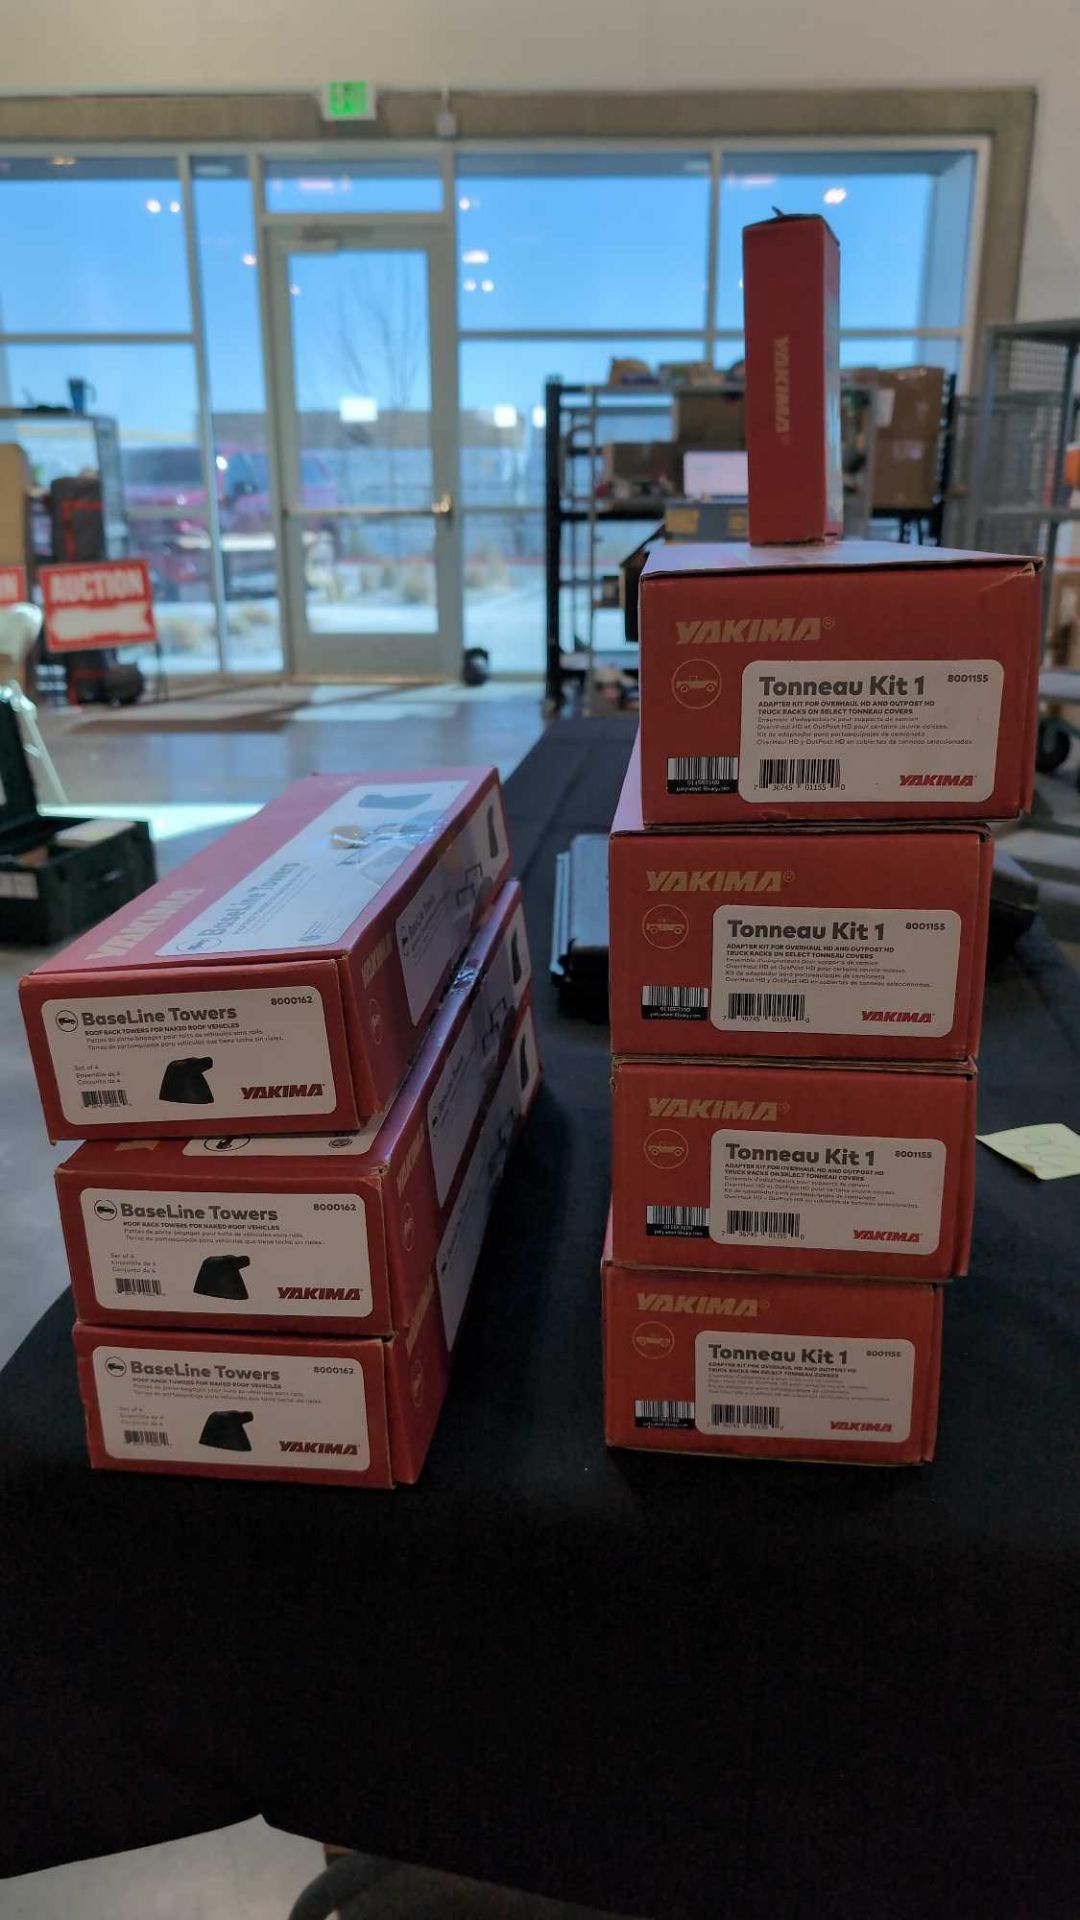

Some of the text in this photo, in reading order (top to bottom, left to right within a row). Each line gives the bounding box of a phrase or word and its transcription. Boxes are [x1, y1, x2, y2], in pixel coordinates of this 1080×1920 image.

[52, 568, 144, 602] AUCTION
[676, 617, 821, 645] YAKIMA
[759, 674, 925, 697] Tonneau Kit 1
[947, 674, 989, 683] 8001155
[900, 775, 974, 787] YAKIMA
[646, 871, 783, 892] YAKIMA
[727, 920, 885, 941] Tonneau Kit 1
[905, 922, 946, 931] 8001155
[271, 996, 313, 1006] 8000162
[82, 1006, 238, 1027] BaseLine Towers
[861, 1010, 933, 1023] YAKIMA
[240, 1083, 323, 1099] YAKIMA
[649, 1098, 778, 1121] YAKIMA
[725, 1142, 875, 1166] Tonneau Kit 1
[894, 1150, 932, 1159] 8001155
[120, 1202, 278, 1221] BaseLine Towers
[313, 1203, 357, 1211] 8000162
[852, 1229, 920, 1243] YAKIMA
[277, 1287, 361, 1301] YAKIMA
[636, 1293, 758, 1316] YAKIMA
[708, 1343, 848, 1364] Tonneau Kit 1
[130, 1360, 280, 1381] BaseLine Towers
[313, 1366, 354, 1374] 8000162
[830, 1420, 892, 1432] YAKIMA
[279, 1440, 359, 1455] YAKIMA
